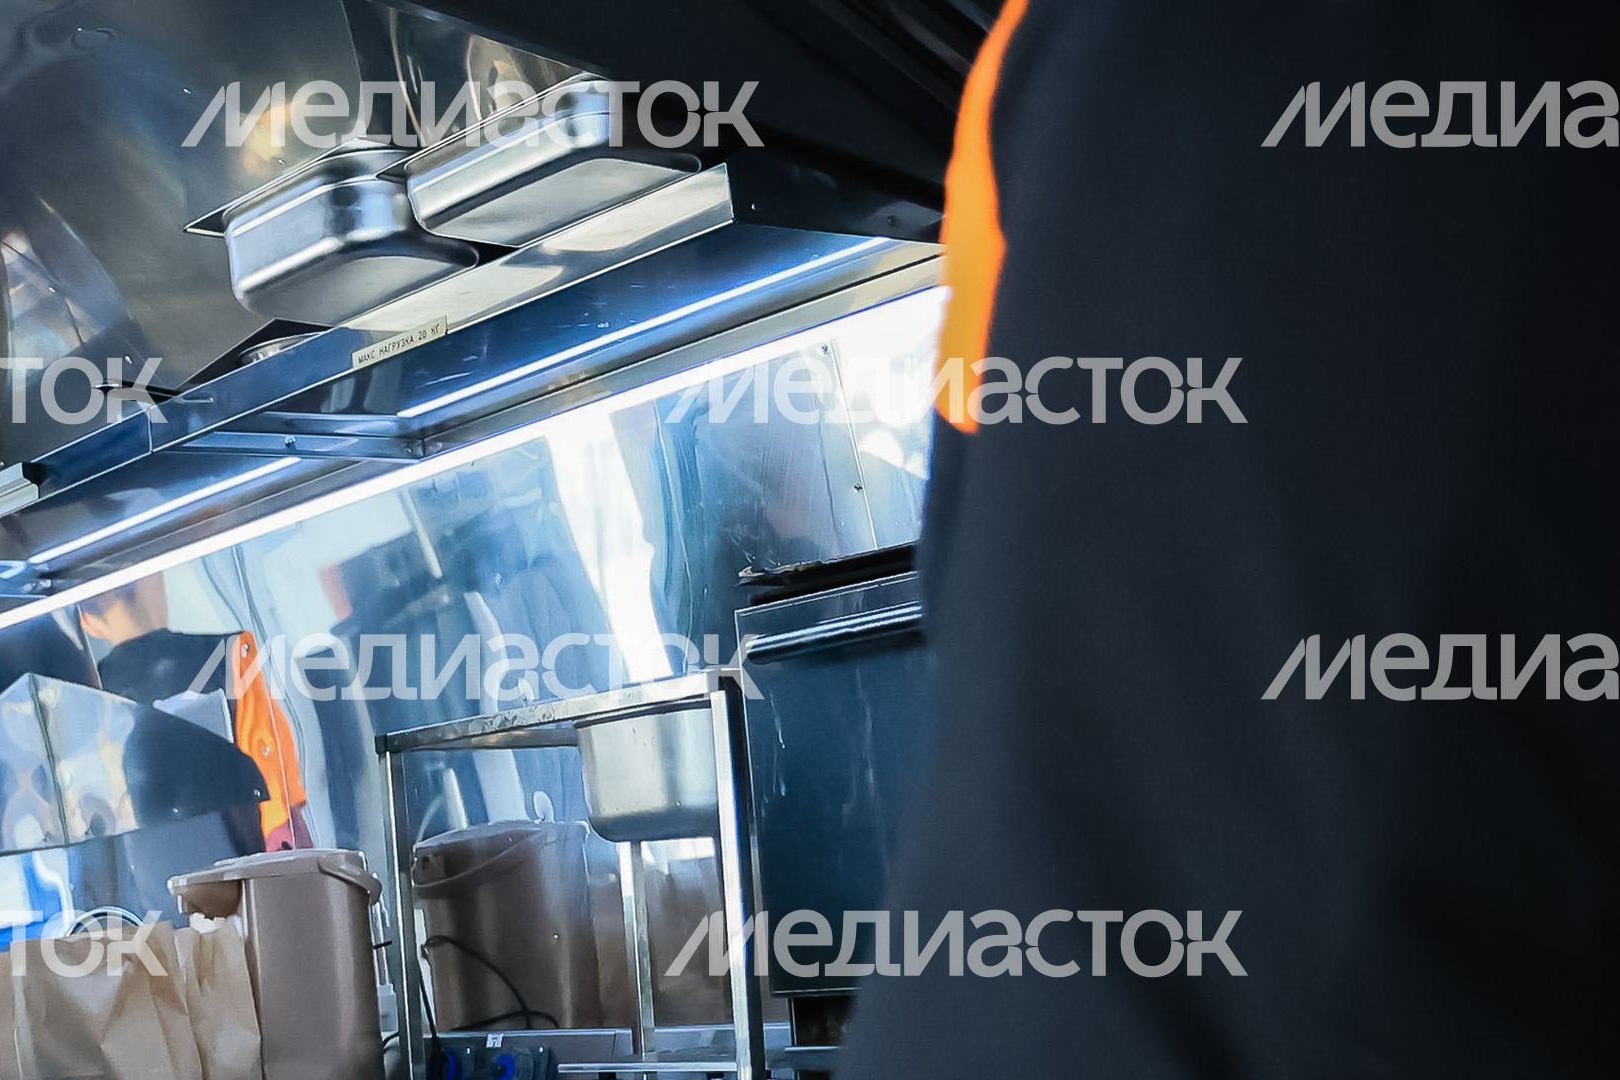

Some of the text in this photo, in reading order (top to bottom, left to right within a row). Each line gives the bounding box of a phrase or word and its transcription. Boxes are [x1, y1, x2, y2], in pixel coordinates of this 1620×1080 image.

[378, 335, 414, 356] НАГРУЗКА
[418, 329, 427, 340] 20
[431, 323, 440, 335] КГ
